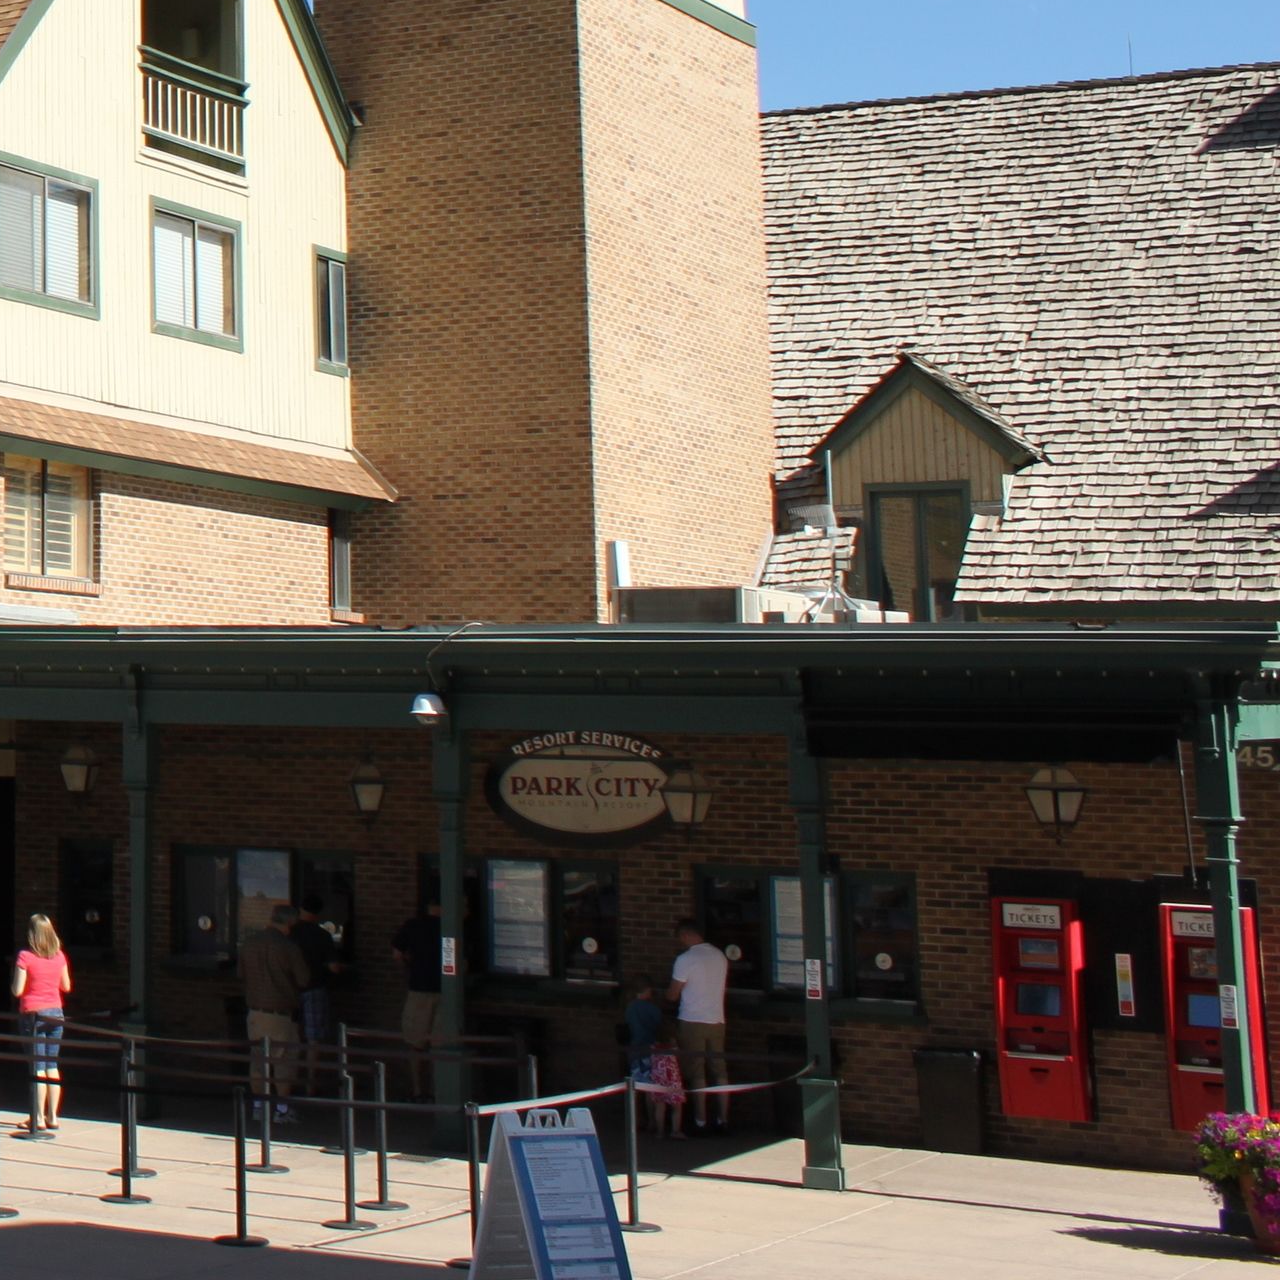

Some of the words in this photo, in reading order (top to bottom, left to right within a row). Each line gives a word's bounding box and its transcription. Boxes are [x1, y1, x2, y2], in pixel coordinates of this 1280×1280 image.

[511, 730, 577, 756] RESORT
[510, 775, 583, 797] PARK
[594, 777, 660, 798] CITY
[1007, 912, 1056, 925] TICKETS
[1177, 921, 1213, 933] TICKE
